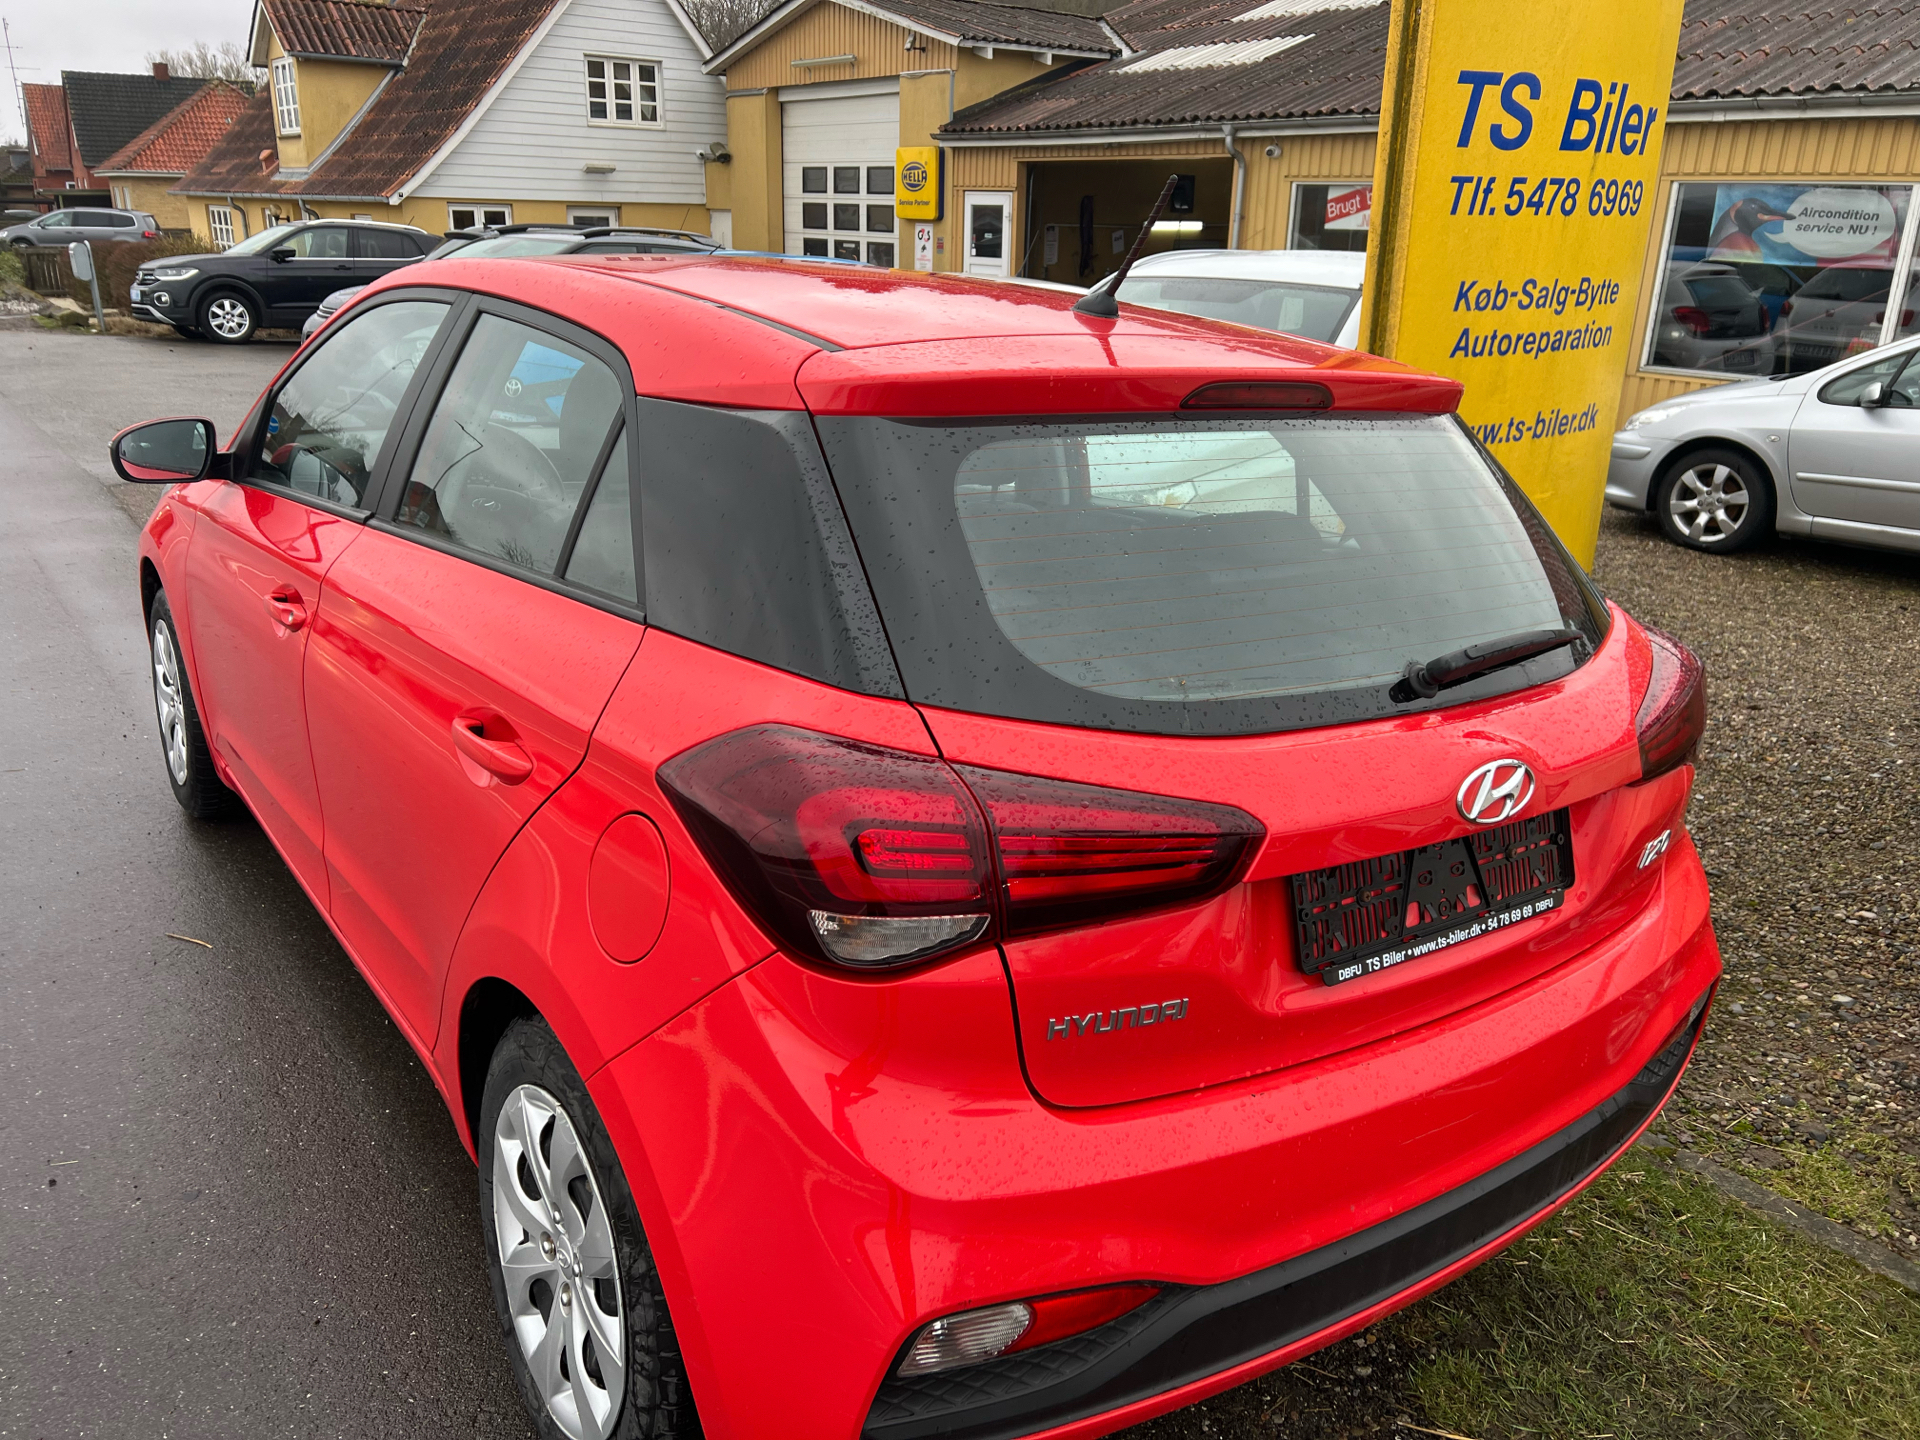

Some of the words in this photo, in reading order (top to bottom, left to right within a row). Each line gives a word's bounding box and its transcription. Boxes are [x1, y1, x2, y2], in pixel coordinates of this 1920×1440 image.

[1456, 70, 1542, 151] TS
[1558, 78, 1658, 156] Biler
[903, 170, 927, 183] HELLA
[1450, 176, 1497, 216] Tlf.
[1504, 177, 1581, 216] 5478
[1588, 178, 1644, 216] 6969
[1327, 194, 1361, 218] Brugt
[1798, 206, 1880, 221] Aircondition
[1795, 223, 1844, 234] service
[1847, 224, 1869, 236] NU
[1453, 277, 1620, 316] Køb-Salg-Bytte
[1449, 319, 1613, 360] Autoreparation
[1338, 963, 1363, 981] DBFU
[1366, 956, 1381, 972] TS
[1382, 950, 1406, 968] Biler
[1412, 922, 1482, 957] www.ts-biler.dk
[1487, 916, 1498, 931] 54
[1499, 912, 1510, 927] 78
[1511, 908, 1522, 922] 69
[1522, 904, 1533, 918] 69
[1535, 897, 1554, 912] DBFU
[1047, 997, 1190, 1041] HYUNDAI
